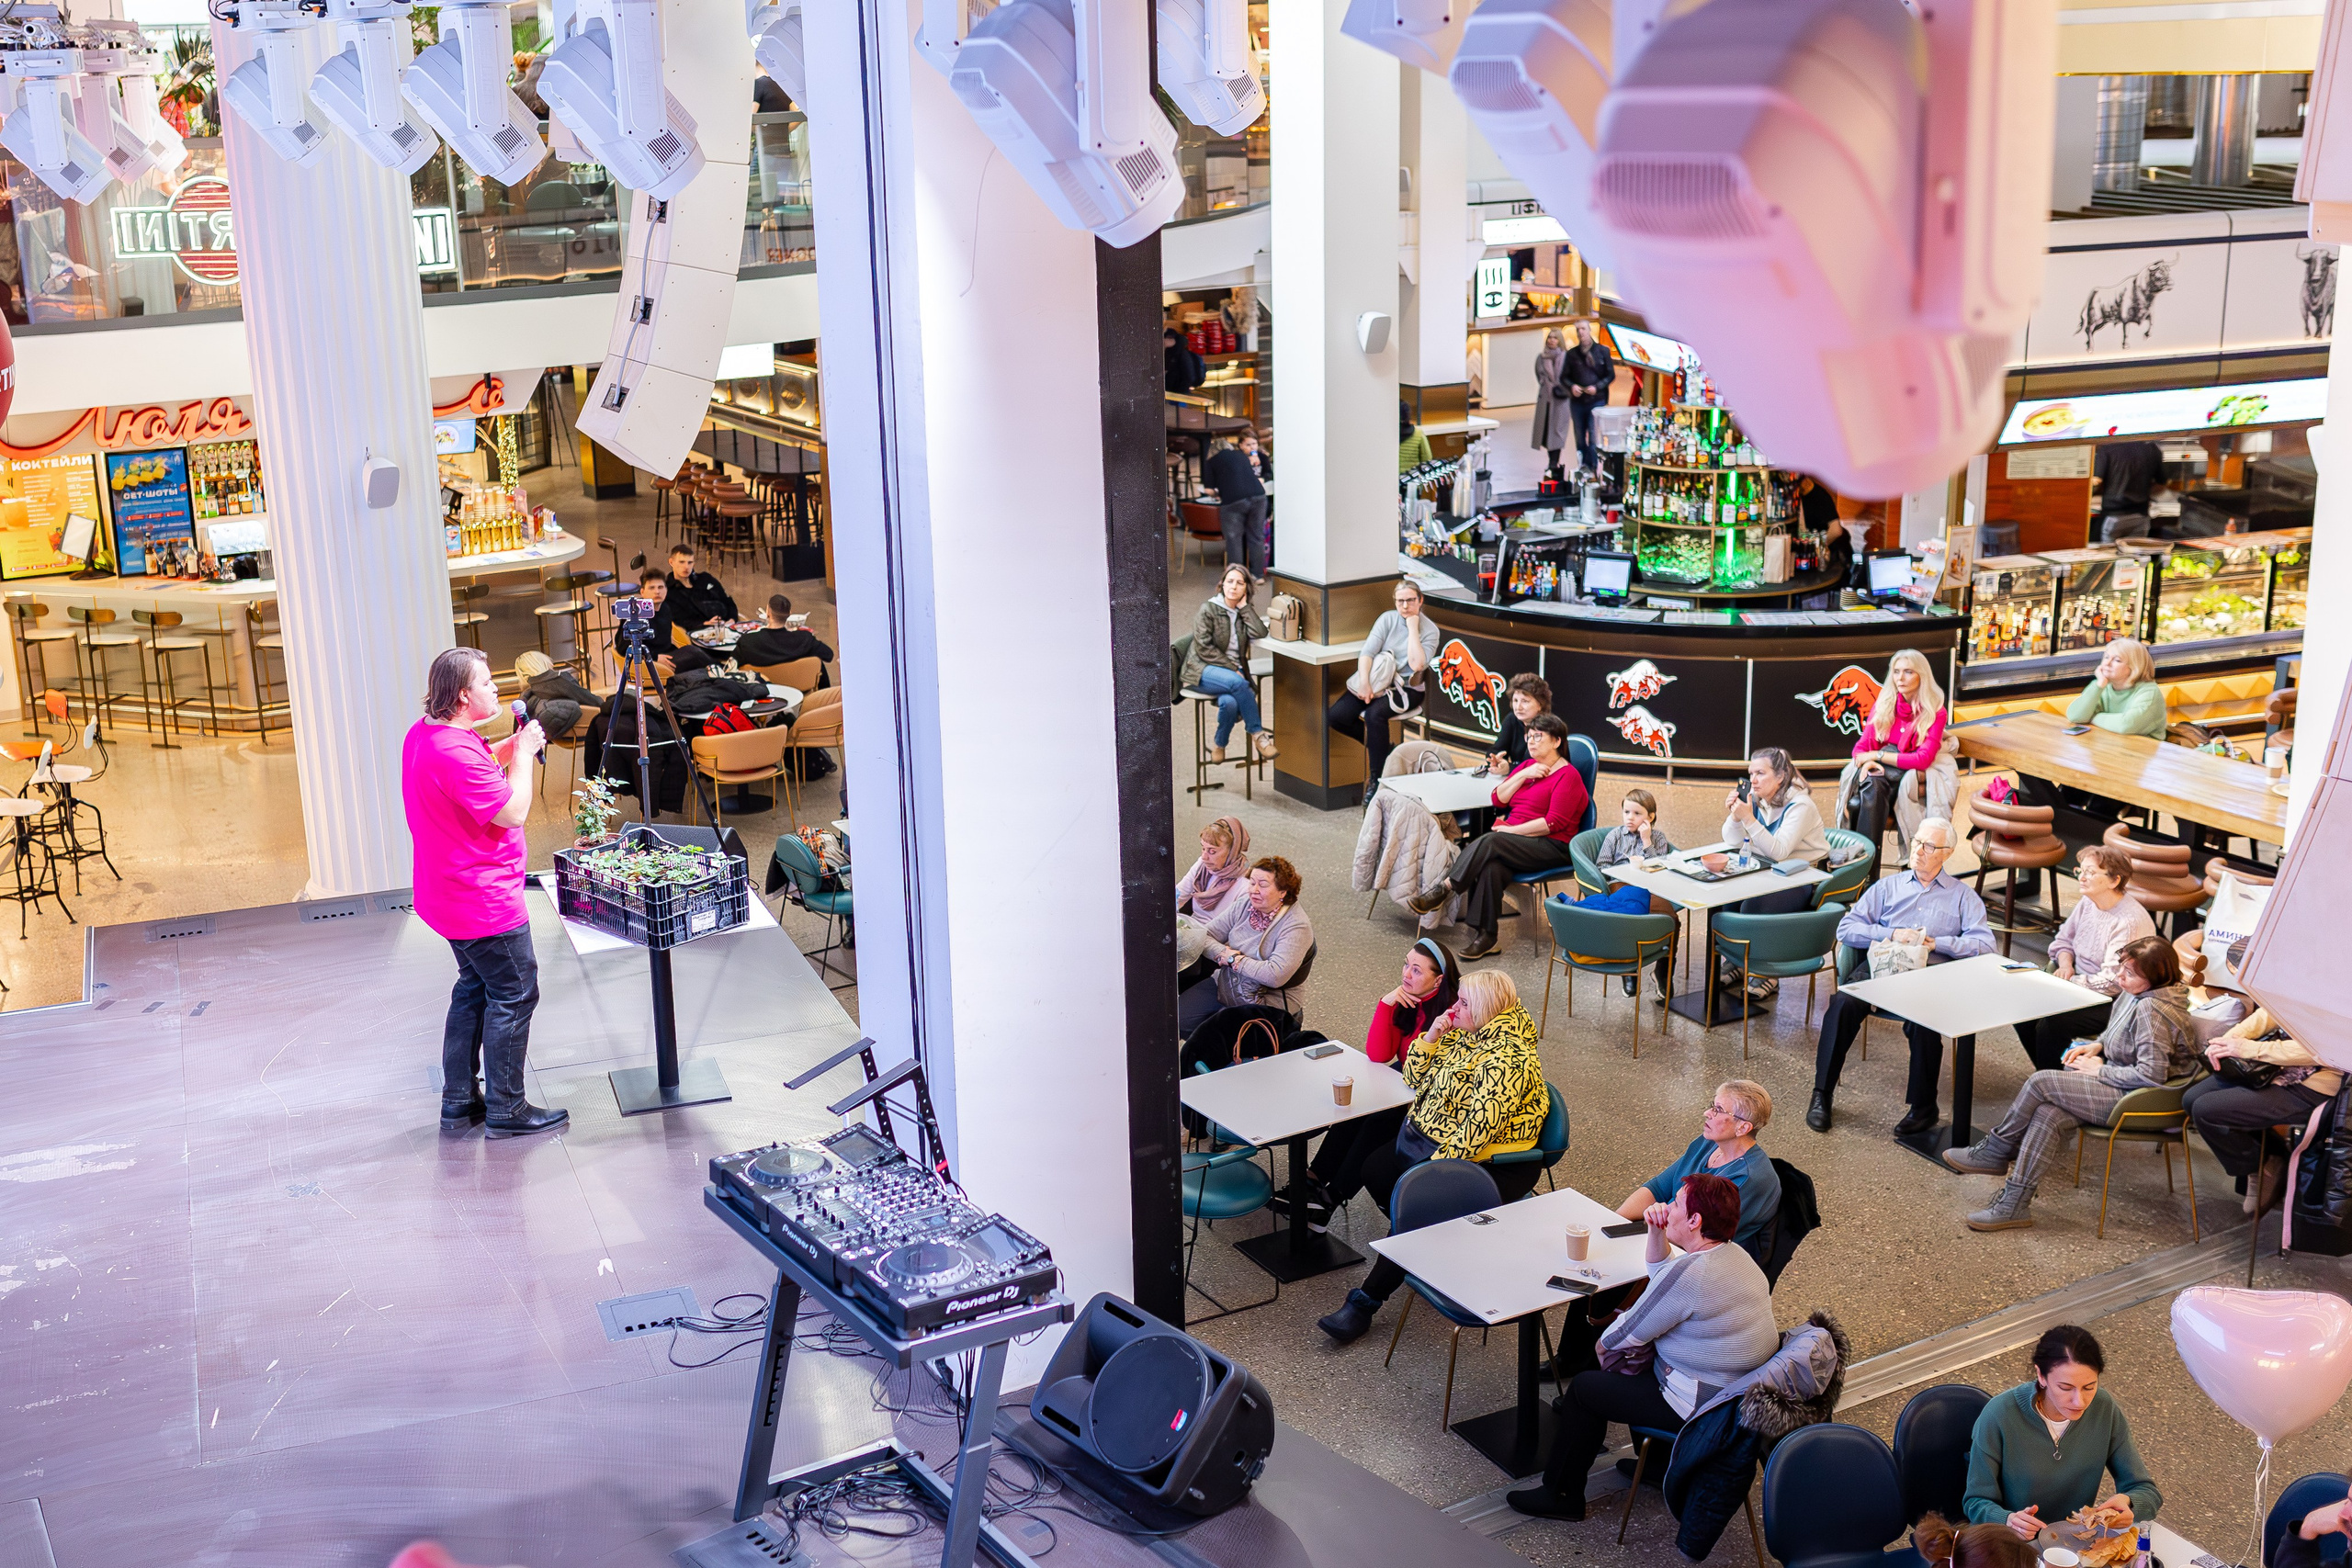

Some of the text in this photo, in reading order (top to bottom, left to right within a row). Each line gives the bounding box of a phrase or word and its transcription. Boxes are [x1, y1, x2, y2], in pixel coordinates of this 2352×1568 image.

[11, 455, 93, 471] КОКТЕЙЛИ
[2208, 929, 2245, 941] АМИН
[782, 1224, 808, 1250] Pioneer
[945, 1291, 1001, 1314] Pioneer
